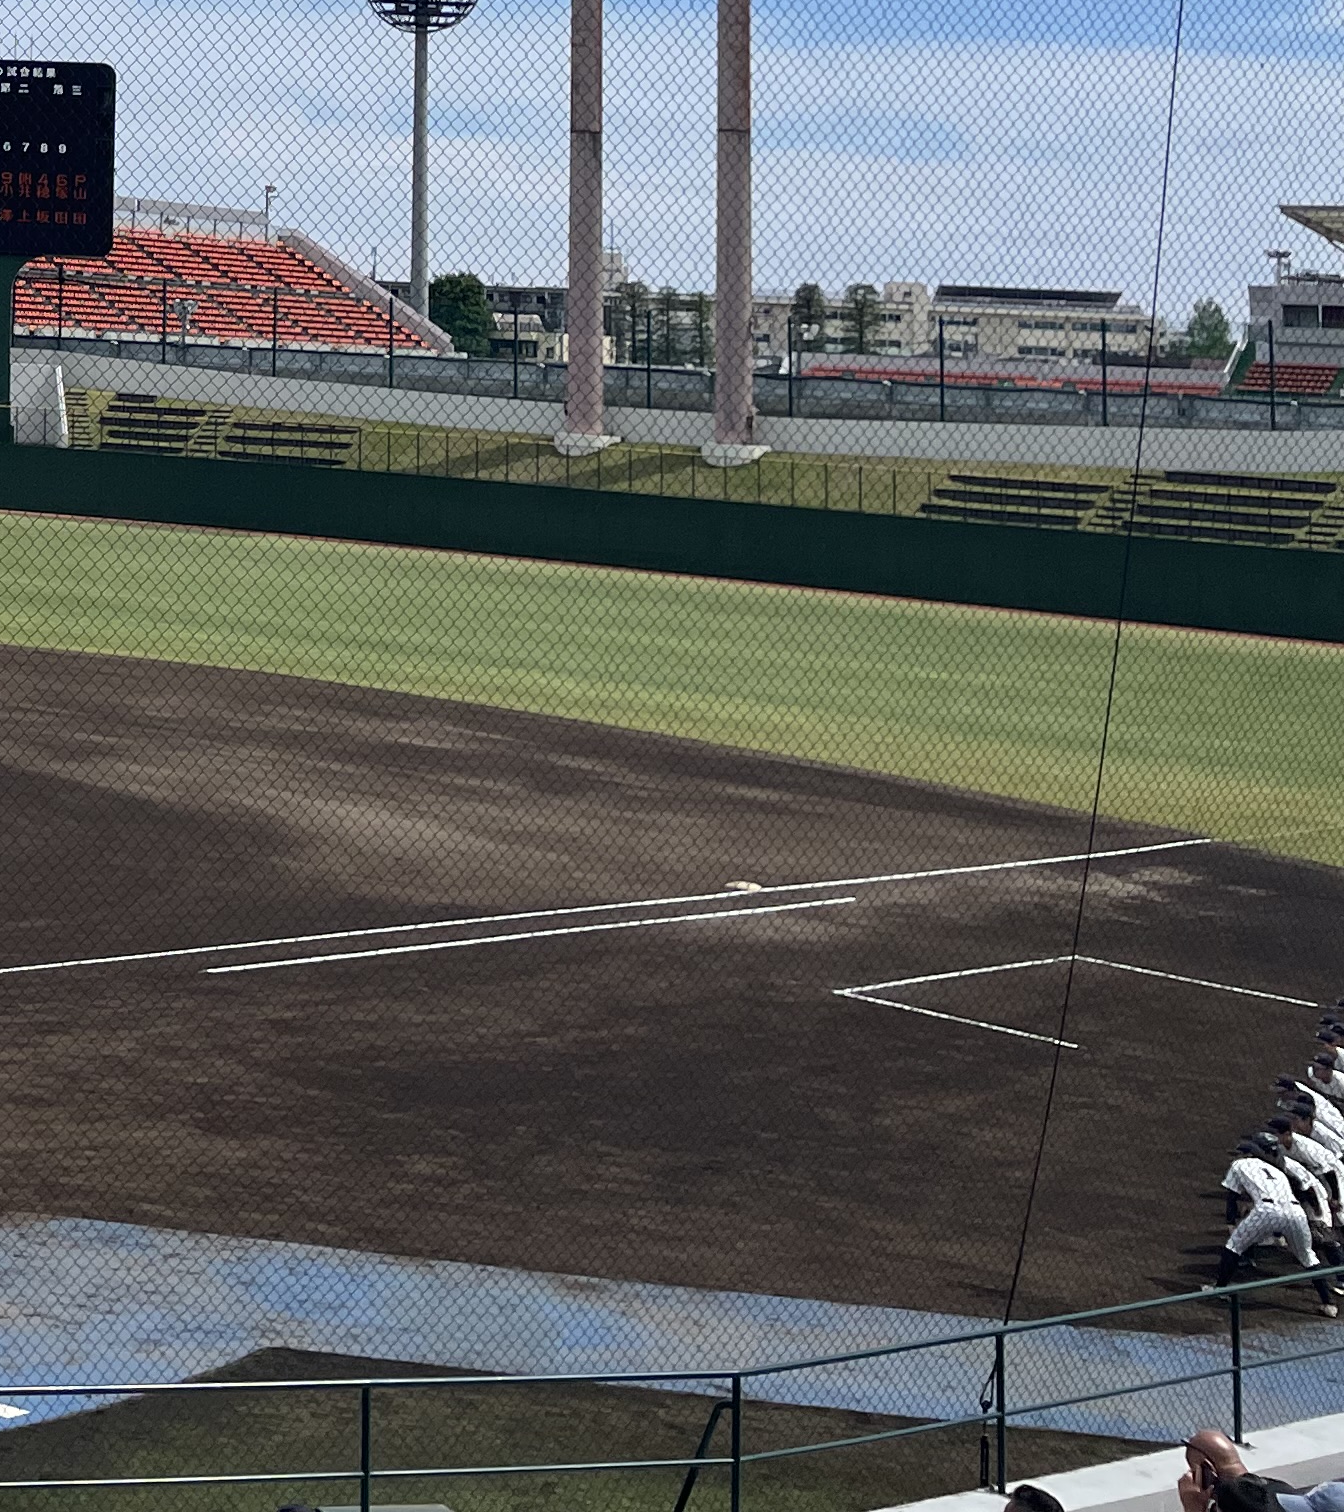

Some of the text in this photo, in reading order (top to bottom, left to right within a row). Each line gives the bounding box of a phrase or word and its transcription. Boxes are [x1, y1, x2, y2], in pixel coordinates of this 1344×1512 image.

[4, 142, 10, 151] 6
[23, 143, 29, 151] 7
[41, 143, 47, 152] 8
[59, 144, 66, 153] 9
